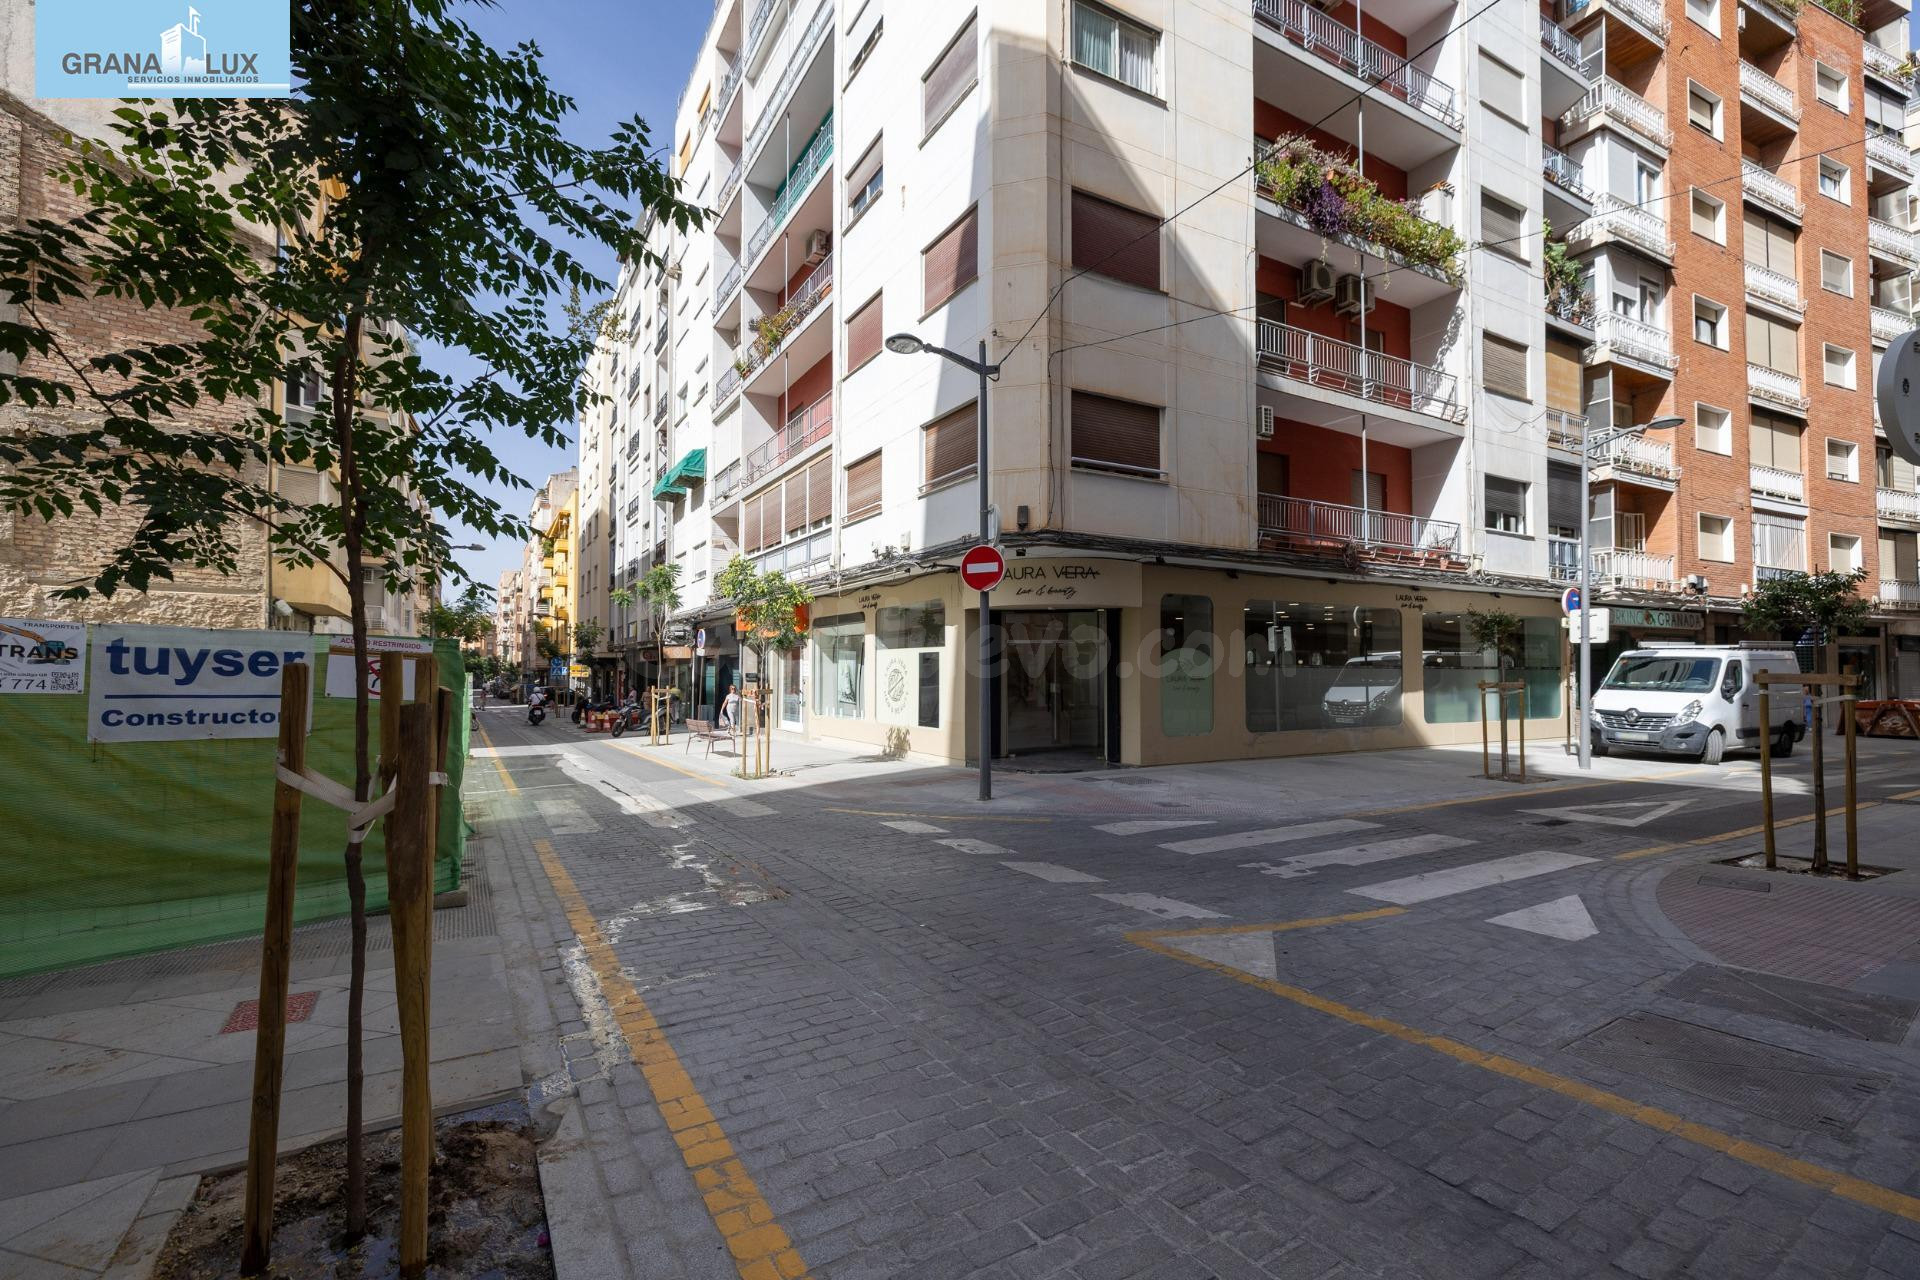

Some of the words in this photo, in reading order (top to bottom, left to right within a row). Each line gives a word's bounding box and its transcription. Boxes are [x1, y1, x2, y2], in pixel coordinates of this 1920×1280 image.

[1003, 566, 1046, 580] AURA
[1053, 566, 1100, 580] VERA
[23, 622, 80, 630] TRANSPORTES
[105, 637, 305, 686] tuyser
[11, 678, 47, 690] 774
[101, 709, 281, 727] Constructo
